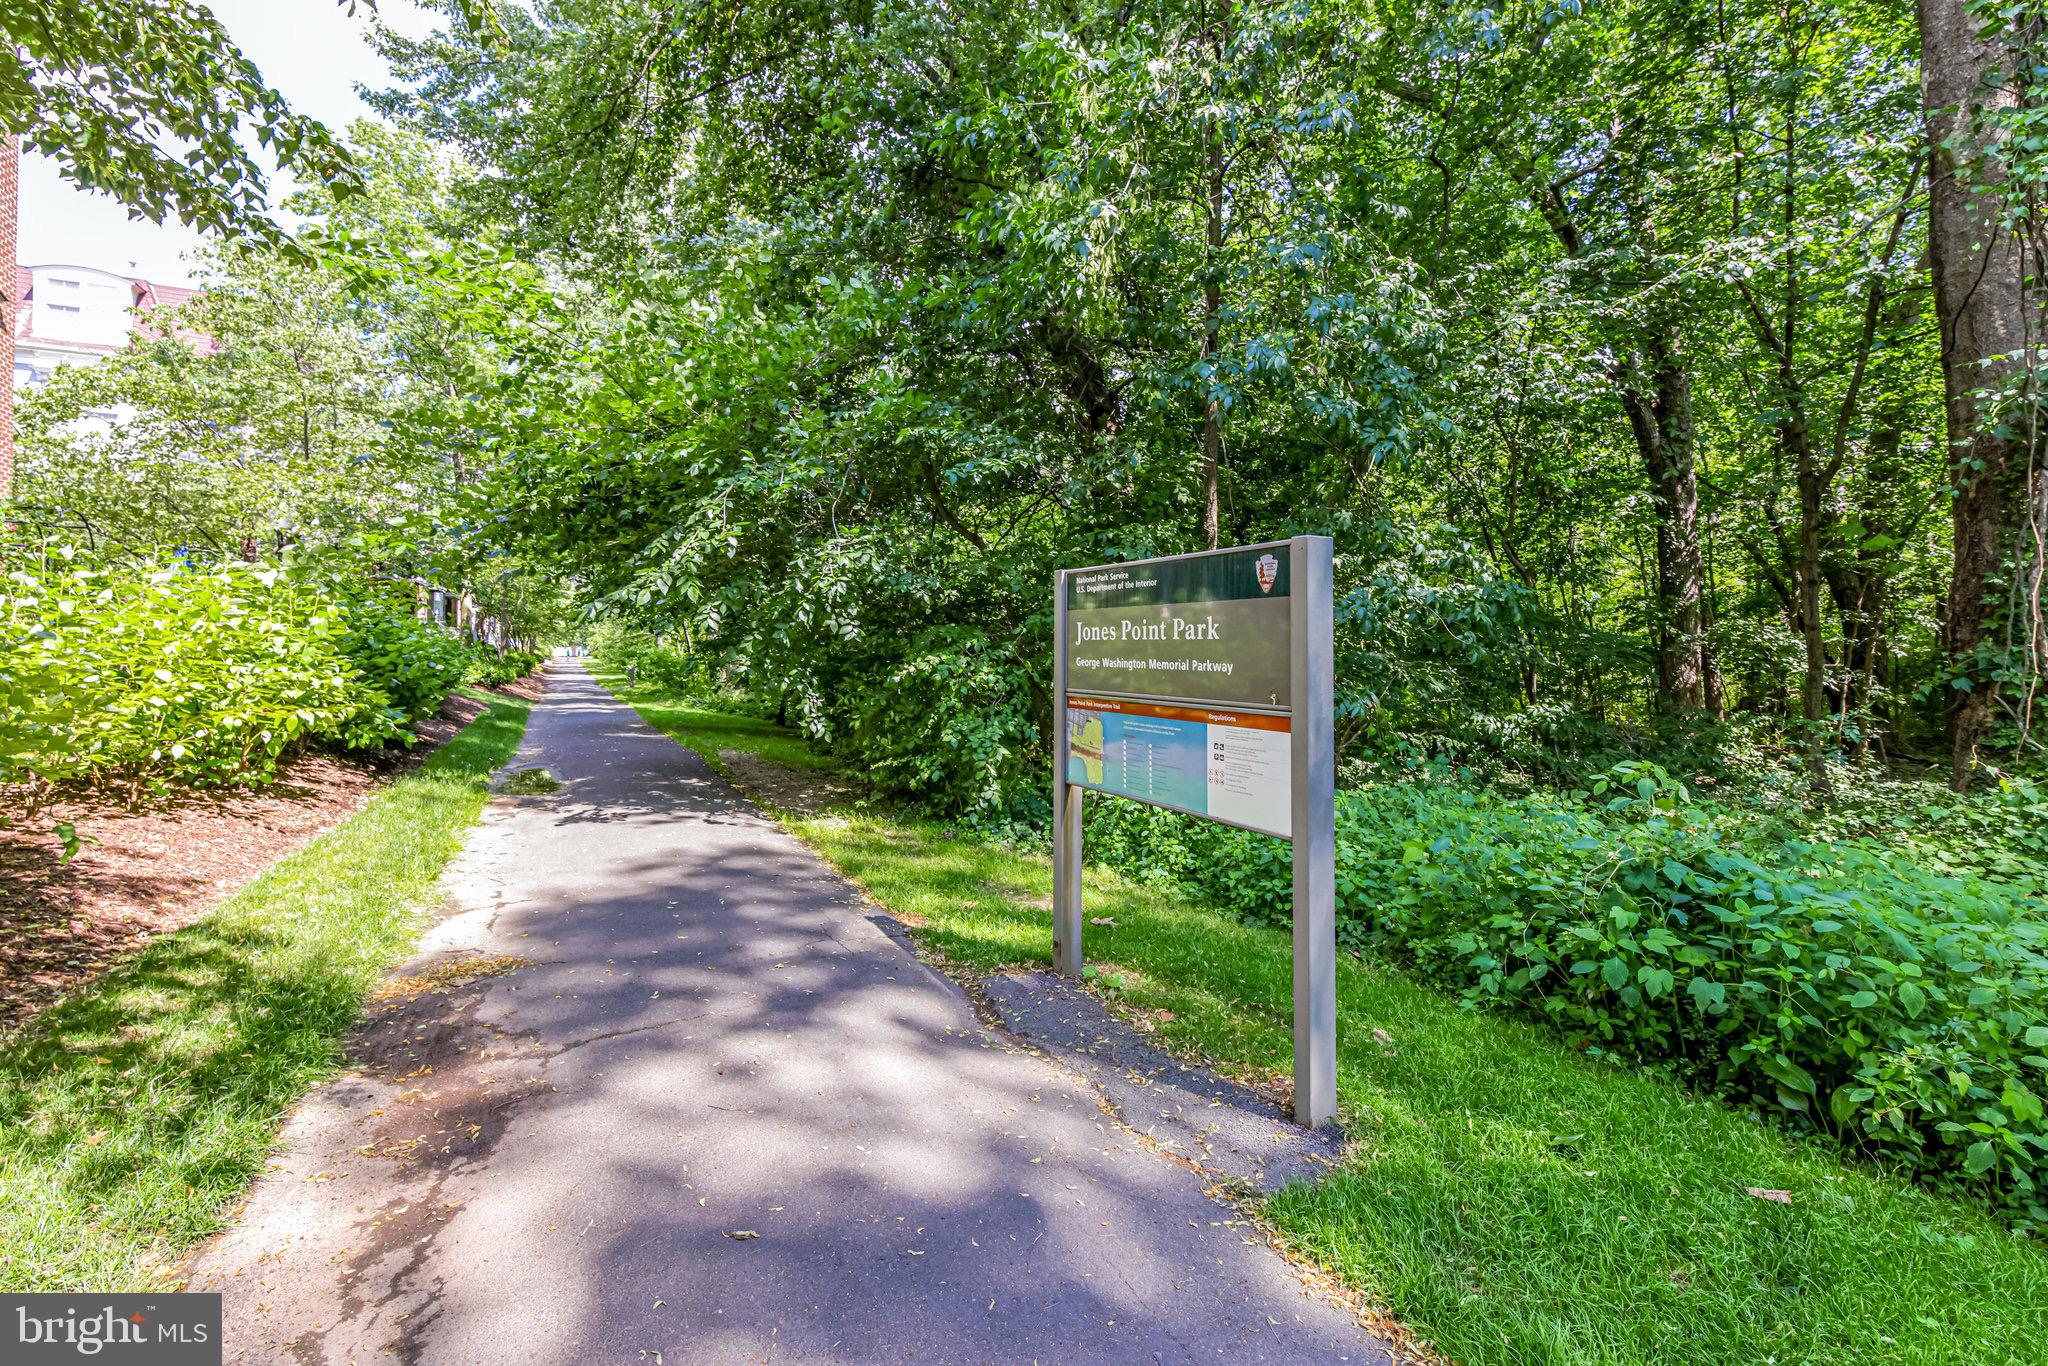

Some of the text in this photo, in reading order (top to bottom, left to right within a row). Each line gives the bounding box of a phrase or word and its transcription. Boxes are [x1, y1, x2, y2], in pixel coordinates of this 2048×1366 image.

[1076, 572, 1129, 584] National Park Service
[1076, 578, 1157, 594] U.S. Department of the Interior
[1075, 615, 1220, 646] Jones Point Park
[1075, 656, 1233, 675] George Washington Memorial Parkway
[1208, 713, 1237, 722] Regulations
